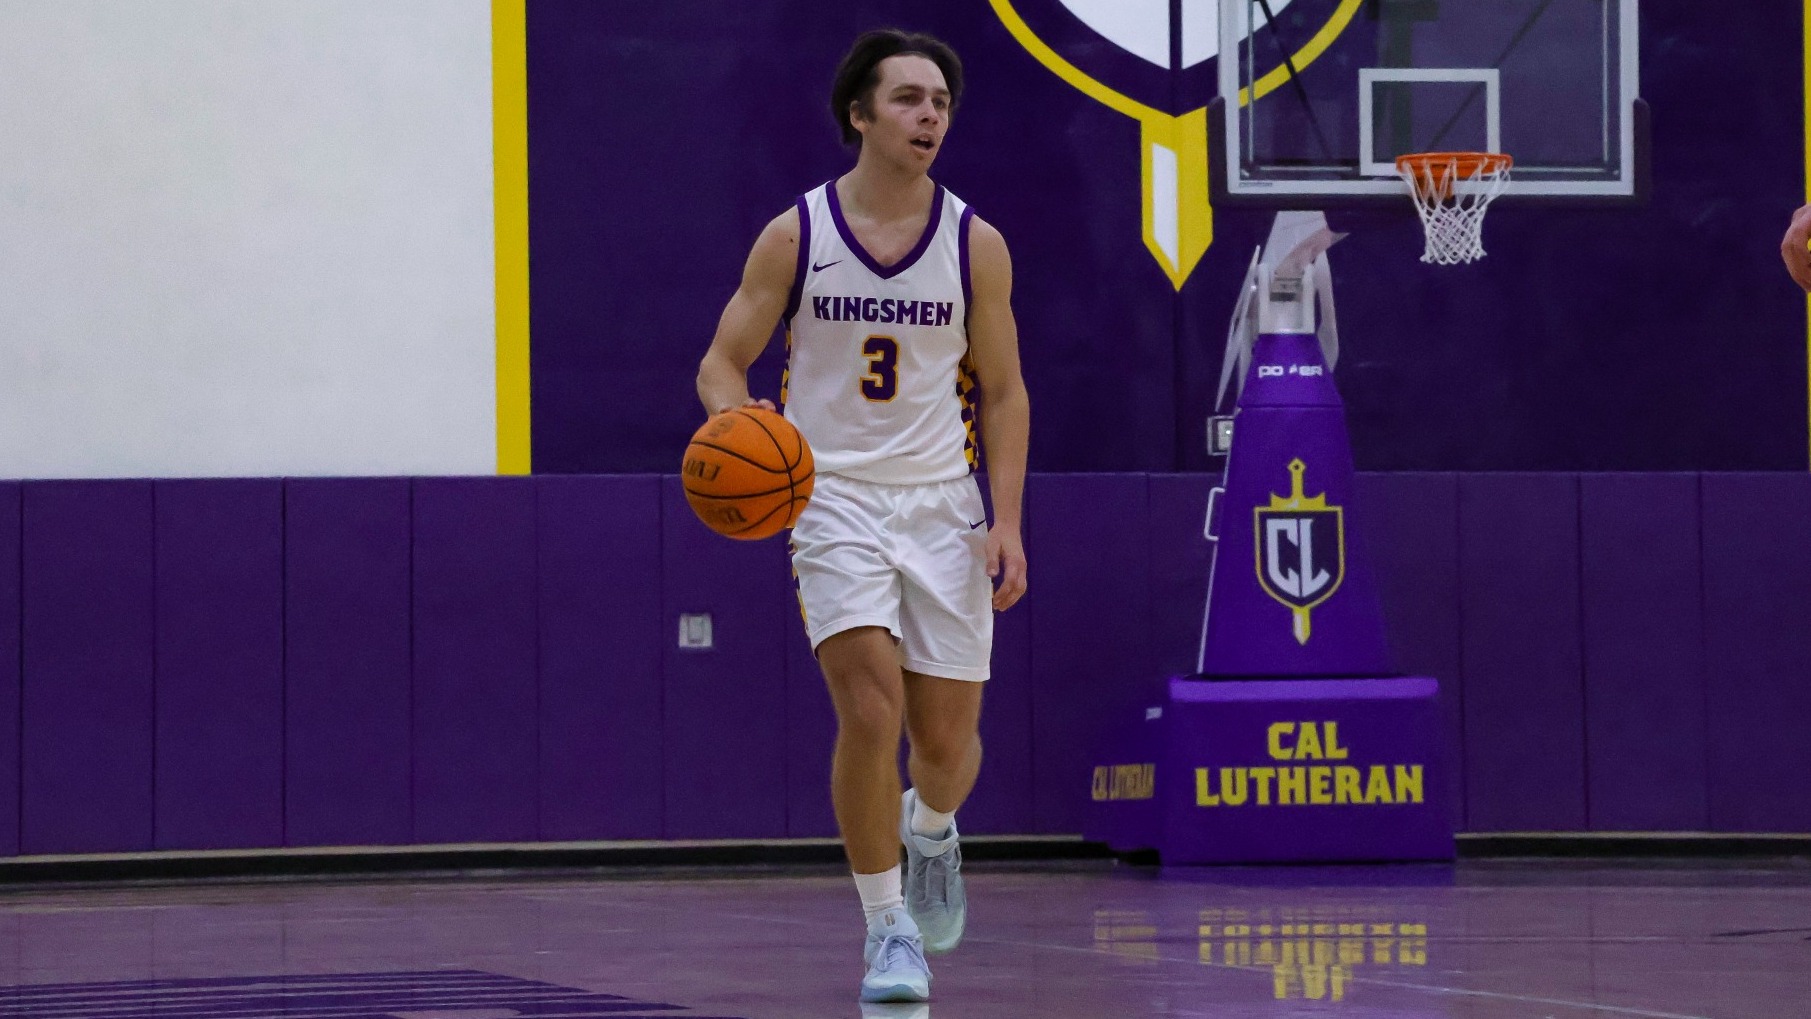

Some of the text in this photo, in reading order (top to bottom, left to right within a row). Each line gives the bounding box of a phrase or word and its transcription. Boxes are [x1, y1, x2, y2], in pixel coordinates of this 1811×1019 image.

[813, 296, 953, 326] KINGSMEN
[860, 334, 899, 403] 3
[1266, 518, 1331, 598] CL
[1267, 721, 1348, 760] CAL
[1195, 764, 1424, 806] LUTHERAN
